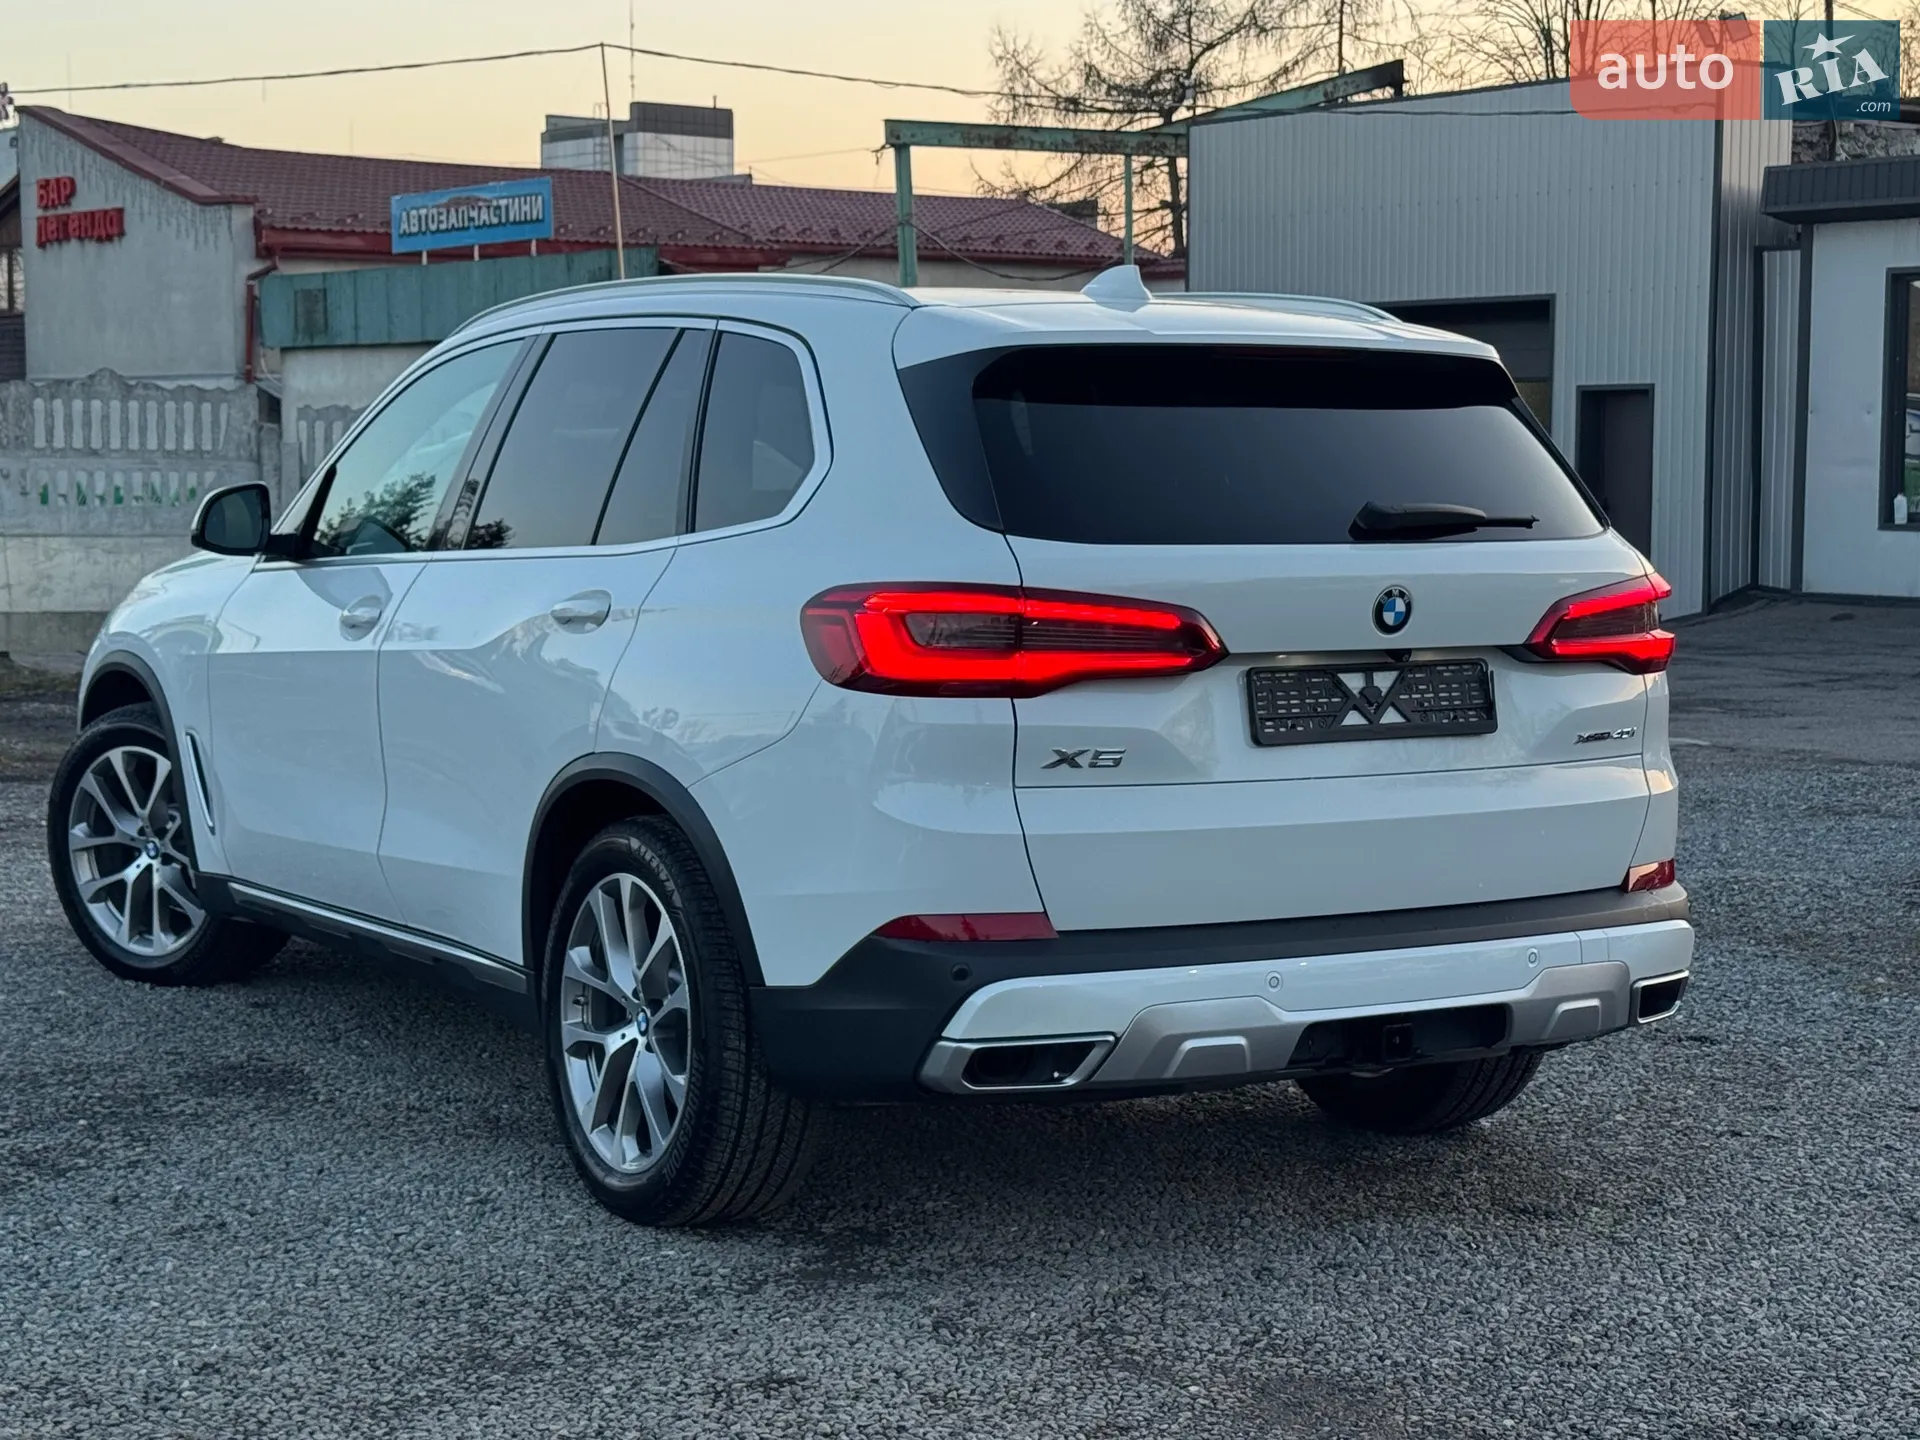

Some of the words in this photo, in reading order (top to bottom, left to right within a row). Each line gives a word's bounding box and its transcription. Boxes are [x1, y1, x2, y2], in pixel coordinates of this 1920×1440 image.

[36, 177, 76, 209] БАР
[399, 194, 543, 236] АВТОЗАПЧАСТИНИ
[1040, 747, 1127, 769] X5
